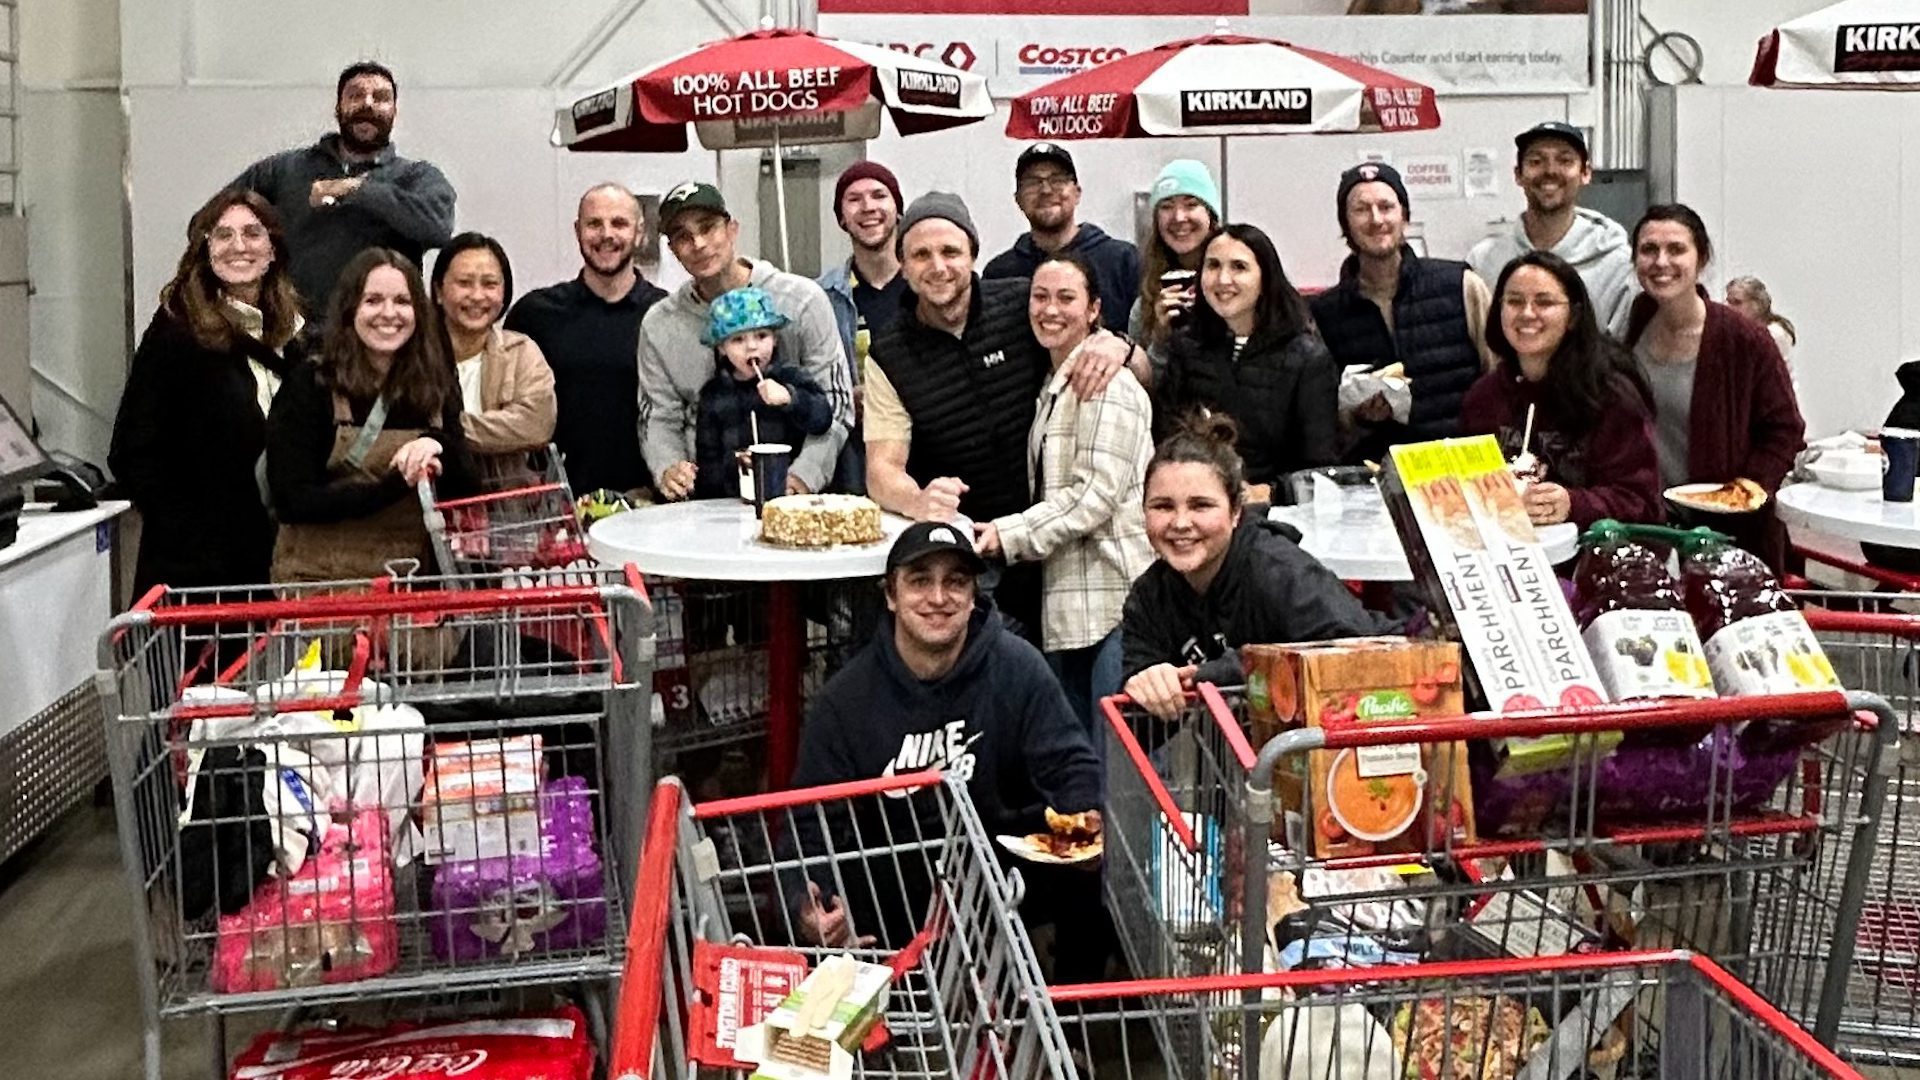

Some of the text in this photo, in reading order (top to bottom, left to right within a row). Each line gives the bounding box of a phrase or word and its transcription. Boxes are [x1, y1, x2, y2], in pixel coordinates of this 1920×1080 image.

[1381, 50, 1428, 64] Counter
[1430, 50, 1452, 63] and
[1454, 51, 1483, 63] start
[1485, 51, 1526, 65] earning
[673, 66, 841, 96] 100% ALL BEEF
[900, 70, 960, 95] KIRKLAND
[693, 90, 819, 115] HOT DOGS
[1030, 93, 1118, 115] 100% ALL BEEF
[1187, 90, 1308, 111] KIRKLAND
[1038, 115, 1103, 135] HOT DOGS
[1453, 552, 1525, 690] PARCHMENT
[1507, 544, 1581, 682] PARCHMENT
[1362, 694, 1412, 717] Pacific
[895, 719, 967, 770] NIKE
